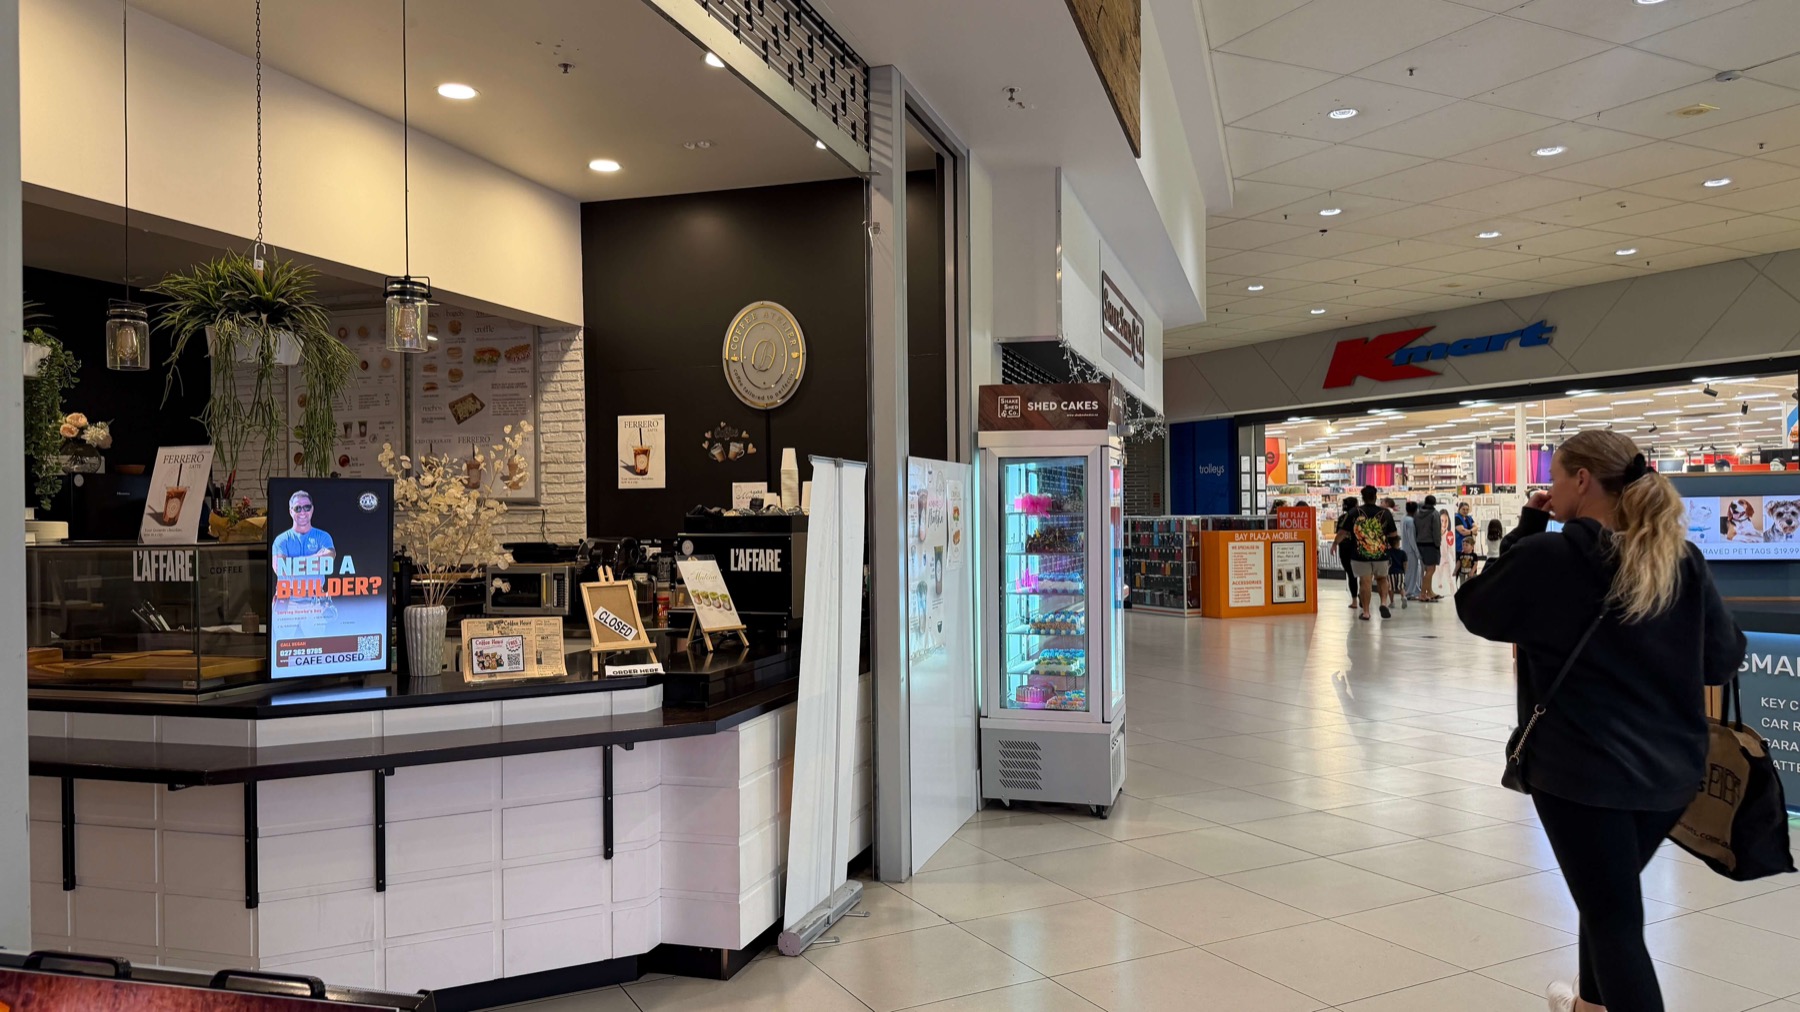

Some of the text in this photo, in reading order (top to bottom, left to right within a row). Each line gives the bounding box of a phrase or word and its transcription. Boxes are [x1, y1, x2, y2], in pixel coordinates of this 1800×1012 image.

[730, 312, 797, 350] COFFEE ATELIER
[1323, 319, 1557, 389] Kmart
[733, 368, 743, 386] coffee
[743, 387, 765, 401] tailored
[775, 367, 796, 398] perfection
[1027, 400, 1099, 411] SHED CAKES
[624, 420, 659, 429] FERRERO
[458, 436, 491, 444] FERRERO
[163, 454, 205, 464] FERRERO
[1199, 463, 1225, 477] trolleys
[1279, 519, 1308, 529] MOBILE
[1235, 531, 1298, 541] BAY PLAZA MOBILE
[1750, 547, 1771, 555] TAGS
[1773, 547, 1800, 555] $19.99
[132, 550, 243, 582] L'AFFARE COFFEE
[277, 555, 356, 576] NEED A
[730, 548, 782, 572] L'AFFARE
[277, 576, 382, 599] BUILDER?
[598, 610, 633, 637] CLOSED
[295, 655, 323, 666] CAFE
[325, 653, 365, 663] CLOSED
[1761, 696, 1786, 709] KEY
[1761, 717, 1789, 731] CAR
[1773, 759, 1800, 773] ATTE
